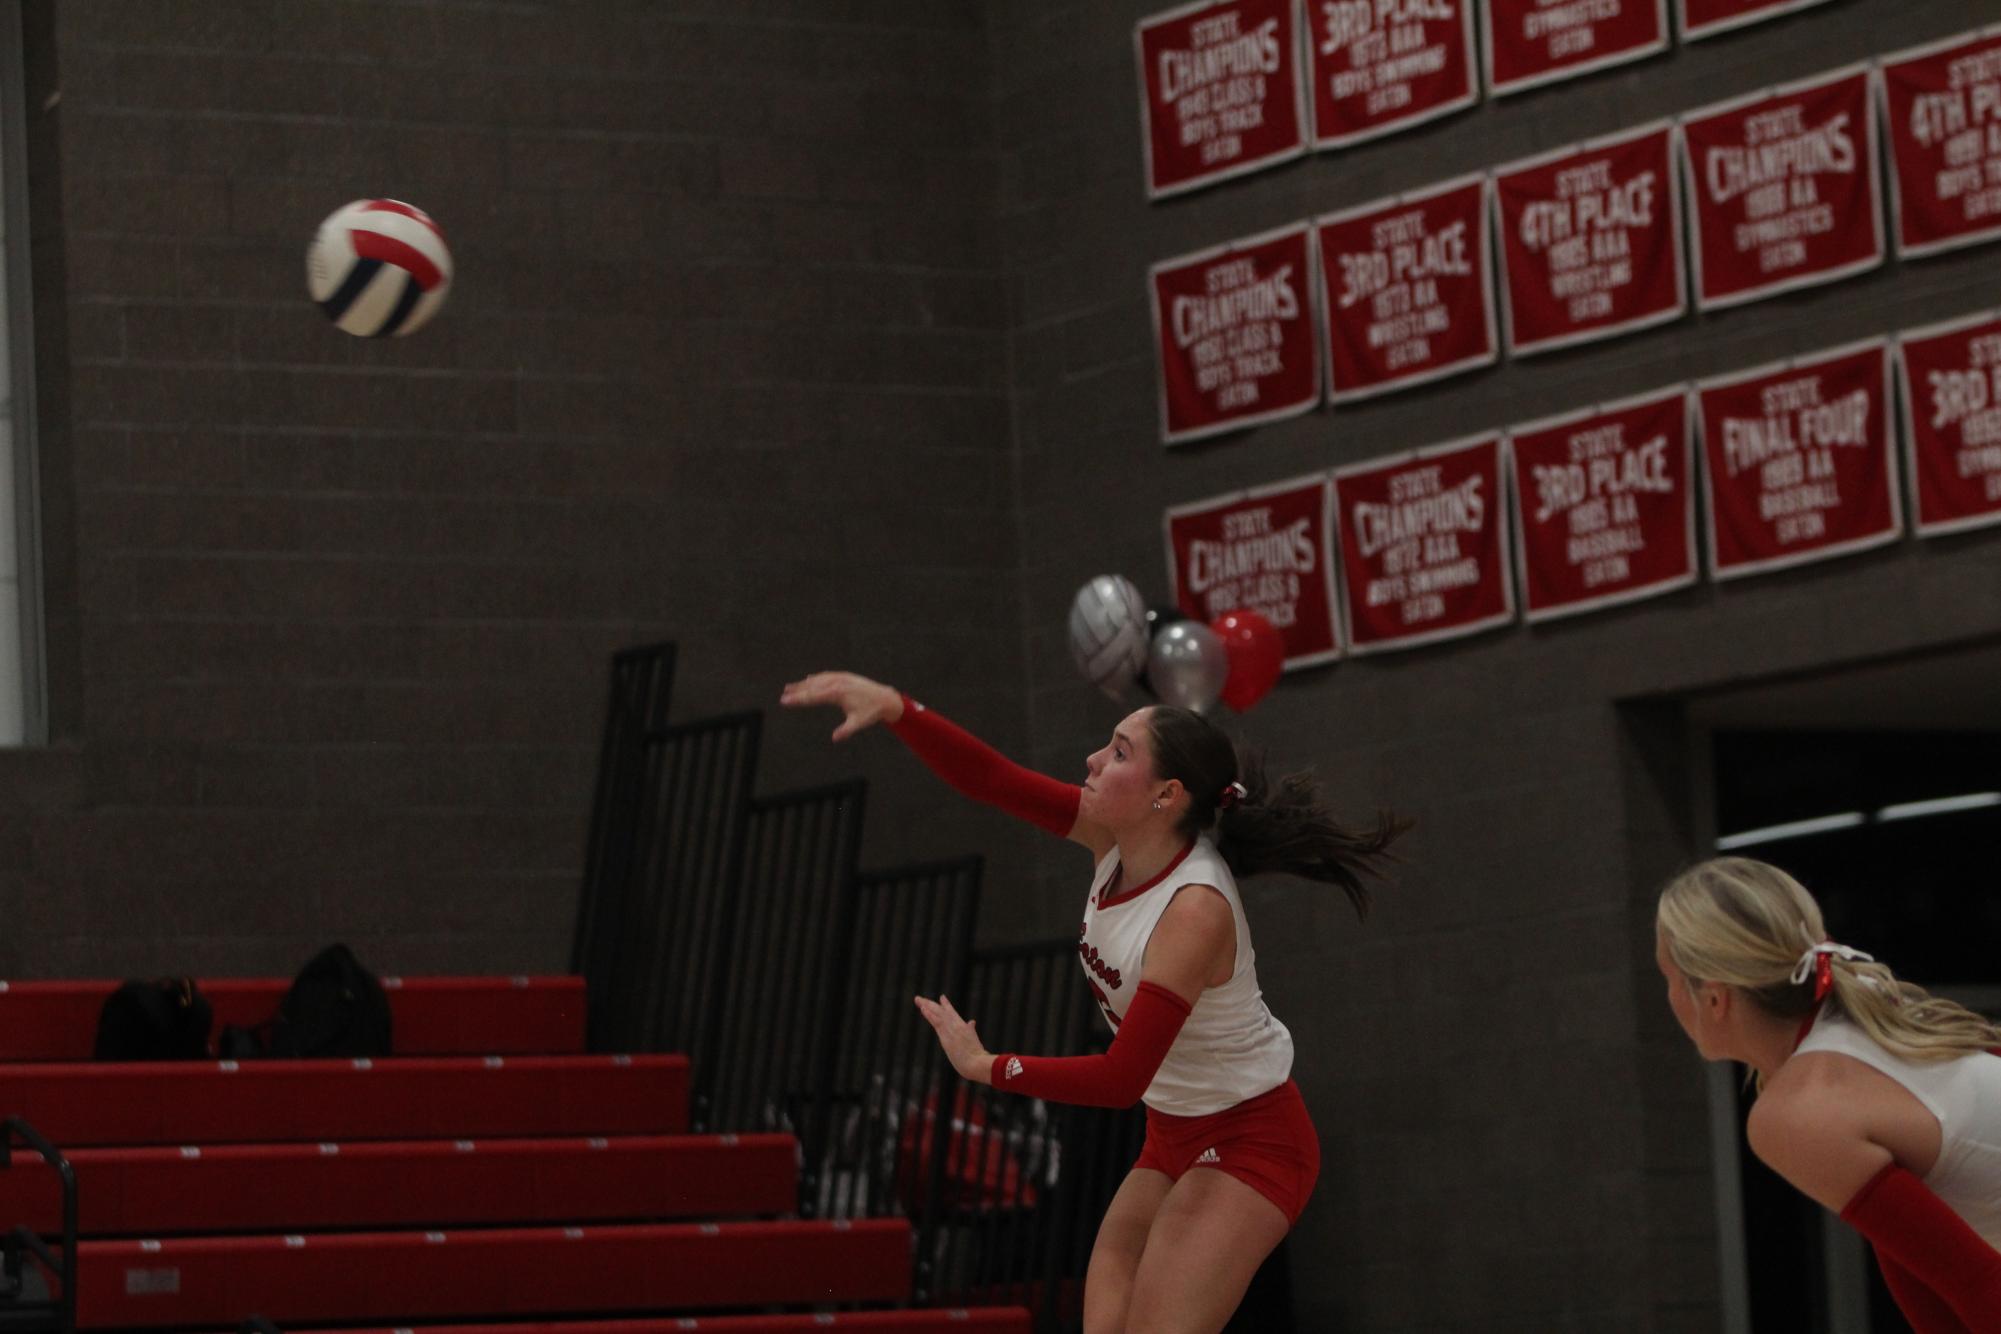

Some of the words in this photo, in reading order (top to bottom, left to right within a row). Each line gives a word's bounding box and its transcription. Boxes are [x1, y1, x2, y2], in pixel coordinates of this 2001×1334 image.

[1191, 11, 1240, 48] STATE
[1322, 0, 1370, 54] 3RD
[1391, 22, 1425, 53] AAA
[1160, 18, 1279, 102] CHAMPIONS
[1332, 69, 1372, 99] BOYS
[1182, 116, 1217, 146] BOYS
[1220, 104, 1264, 131] TRACK
[1746, 105, 1802, 145] STATE
[1911, 93, 1966, 147] 4TH
[1707, 114, 1853, 202] CHAMPIONS
[1556, 160, 1610, 198] STATE
[1791, 178, 1817, 205] AA
[1937, 165, 1982, 198] BOYS
[1520, 202, 1571, 250] 4TH
[1576, 171, 1654, 231] PLACE
[1736, 203, 1833, 251] GYMNASTICS
[1374, 212, 1424, 248] STATE
[1592, 229, 1630, 260] AAA
[1207, 259, 1253, 291] STATE
[1340, 251, 1388, 308] 3RD
[1393, 221, 1471, 280] PLACE
[1174, 264, 1298, 346] CHAMPIONS
[1415, 279, 1438, 306] AA
[1200, 366, 1232, 391] BOYS
[1235, 352, 1283, 376] TRACK
[1762, 377, 1820, 415] STATE
[1929, 370, 1987, 428] 3RD
[1570, 424, 1623, 461] STATE
[1723, 419, 1796, 477] FINAL
[1800, 390, 1868, 447] FOUR
[1534, 465, 1585, 522] 3RD
[1590, 435, 1673, 495] PLACE
[1808, 448, 1835, 477] AA
[1390, 466, 1442, 502] STATE
[1224, 507, 1271, 540] STATE
[1355, 474, 1483, 556] CHAMPIONS
[1613, 494, 1638, 522] AA
[1190, 518, 1315, 592] CHAMPIONS
[1424, 535, 1460, 562] AAA
[1367, 577, 1408, 606] BOYS
